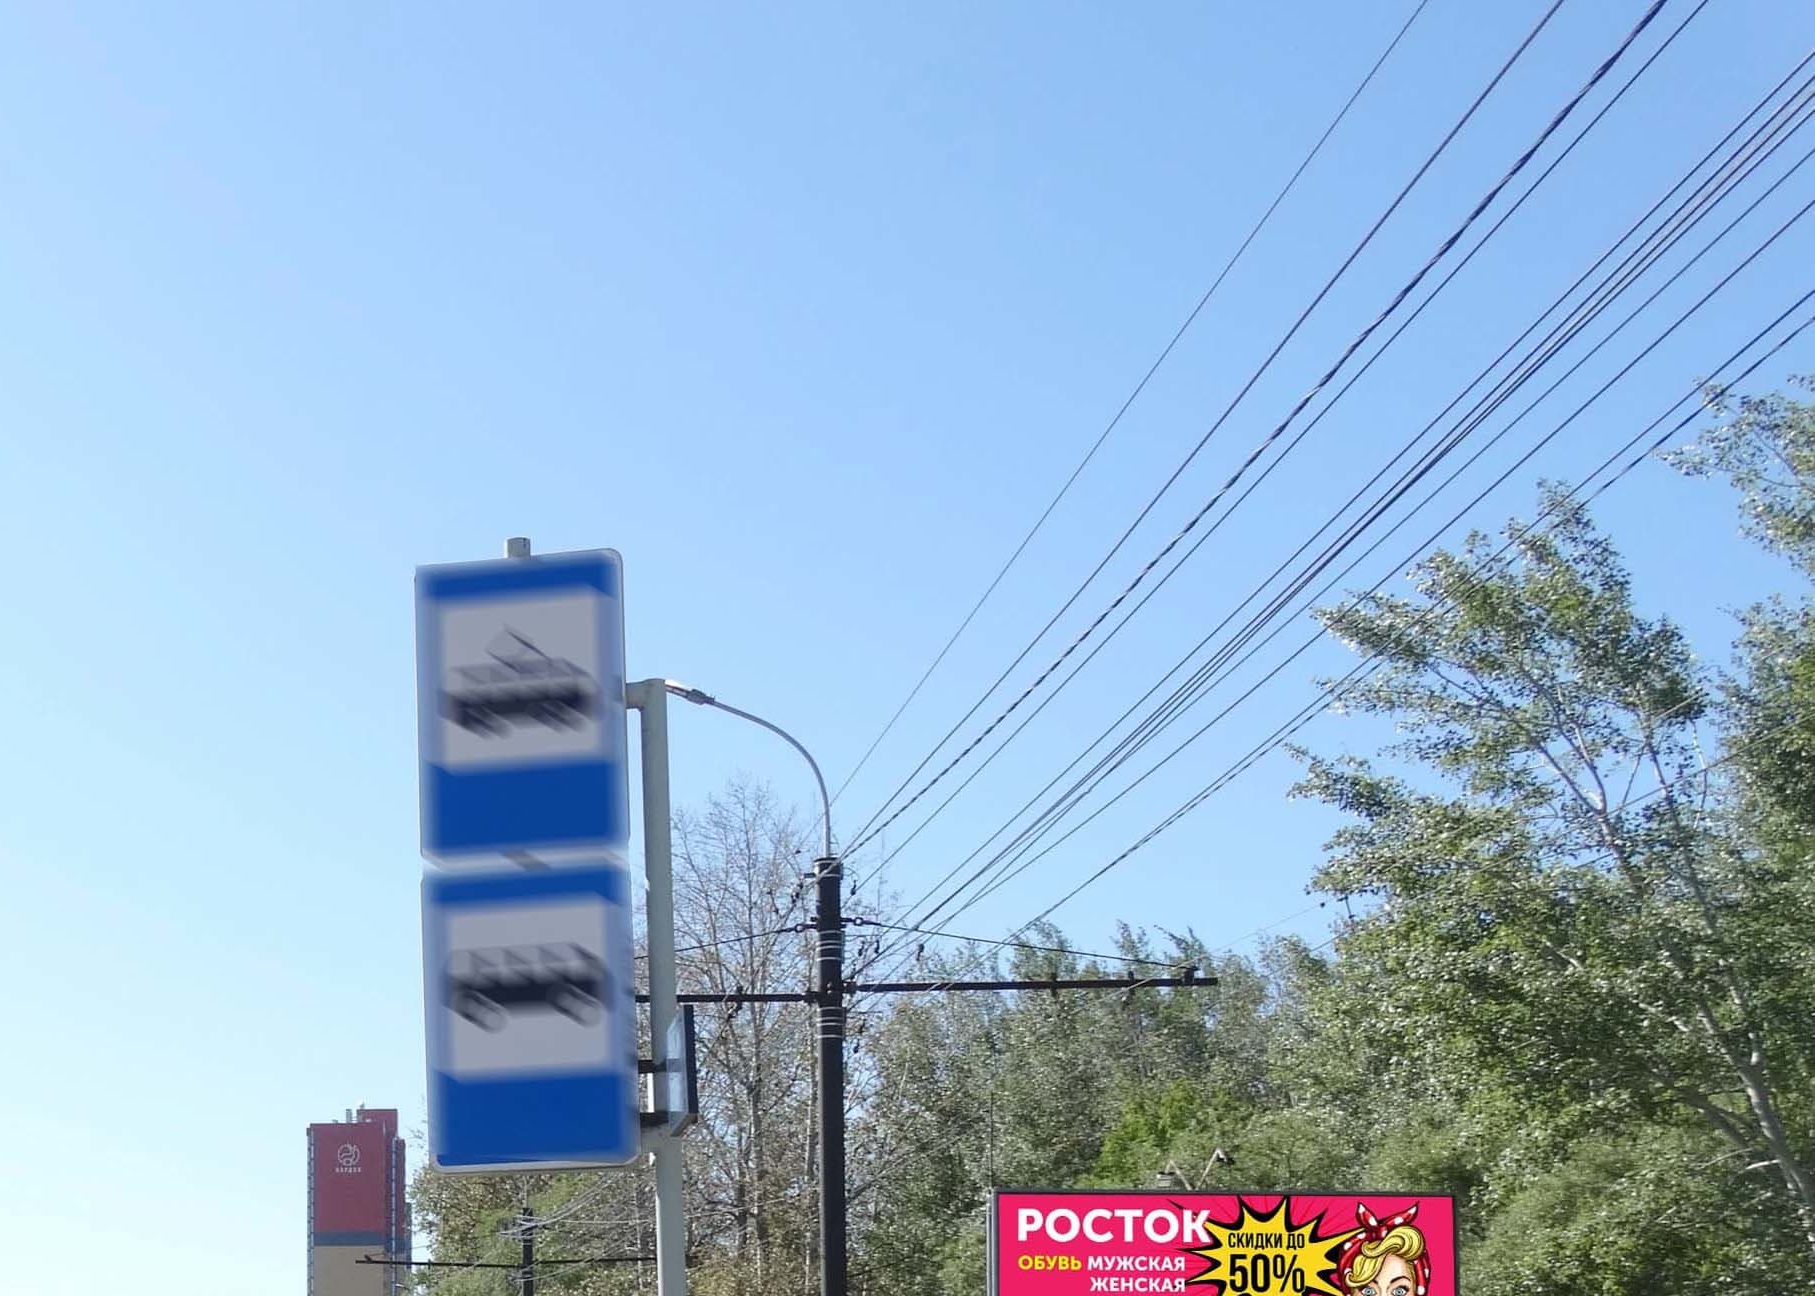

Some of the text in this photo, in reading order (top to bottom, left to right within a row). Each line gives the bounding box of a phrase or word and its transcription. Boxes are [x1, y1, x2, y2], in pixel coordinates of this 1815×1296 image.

[1017, 1208, 1211, 1244] РОСТОК
[1227, 1232, 1305, 1251] СКИДКИ ДО
[1018, 1255, 1186, 1272] ОБУВЬ МУЖСКАЯ
[1228, 1253, 1305, 1294] 50%
[1089, 1276, 1186, 1293] ЖЕНСКАЯ
